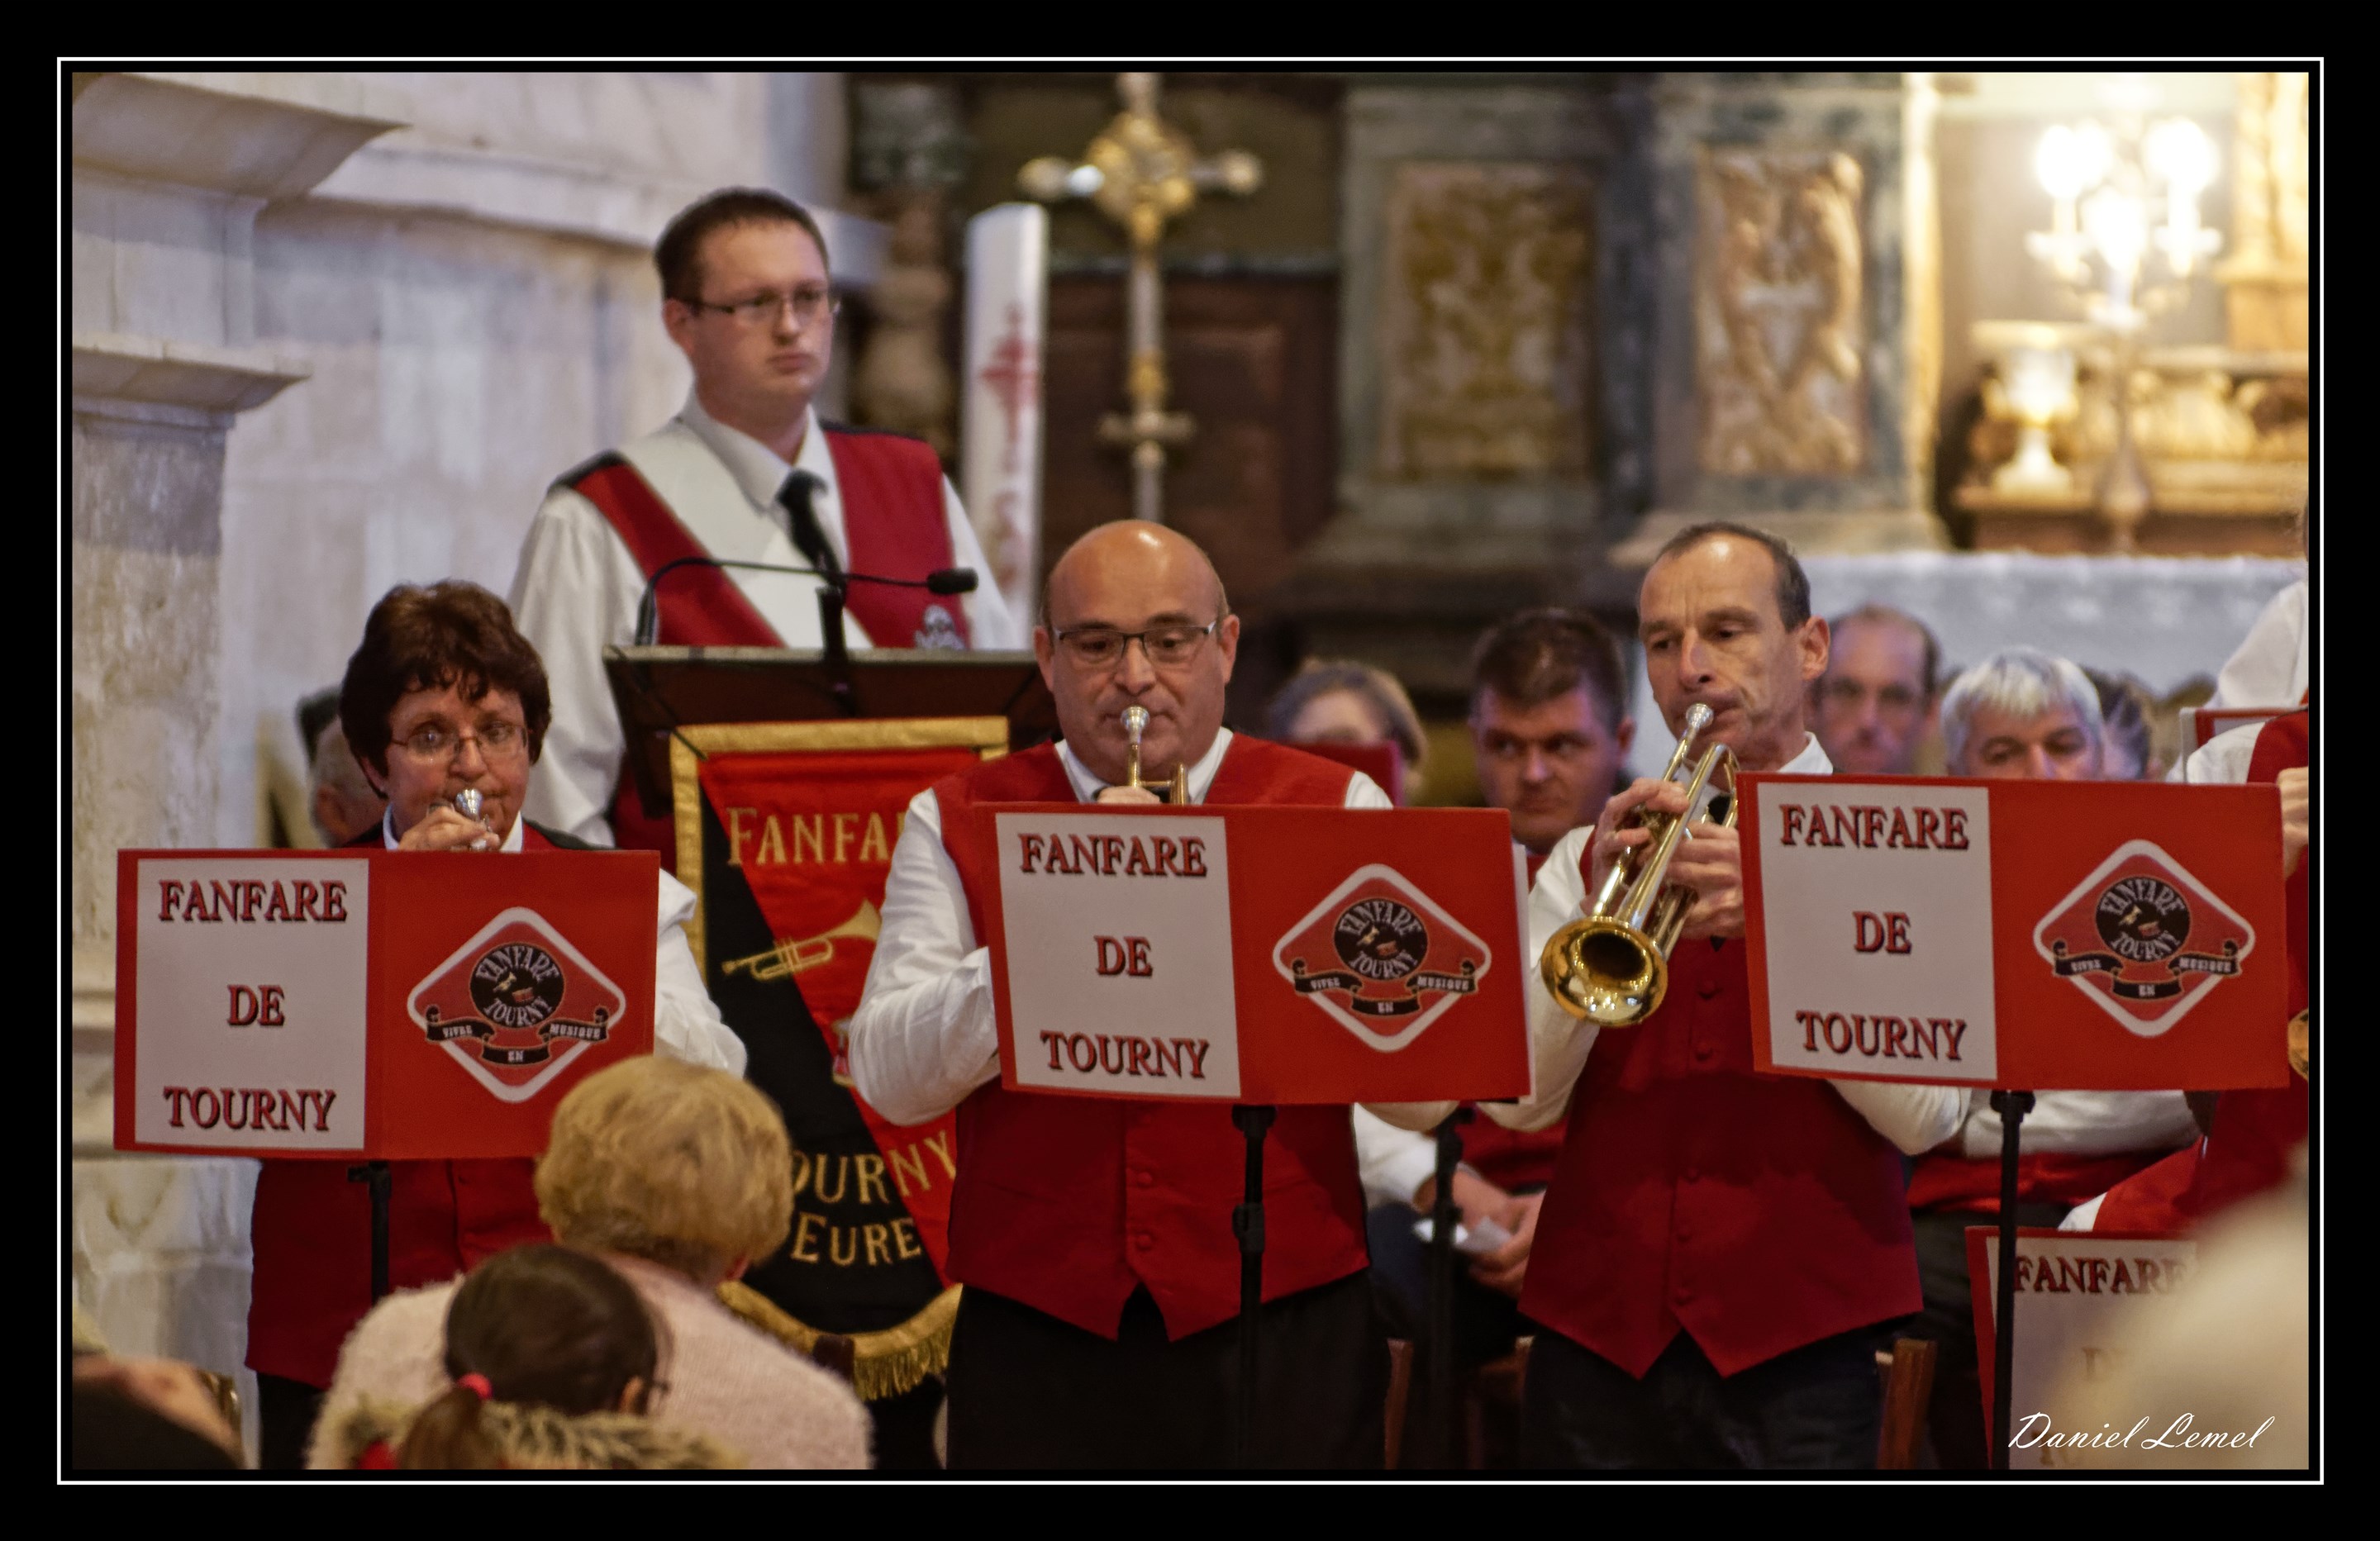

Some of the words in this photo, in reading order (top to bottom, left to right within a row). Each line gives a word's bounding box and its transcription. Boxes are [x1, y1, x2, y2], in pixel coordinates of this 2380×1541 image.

[1780, 804, 1969, 850] FANFARE
[1018, 834, 1207, 878] FANFARE
[159, 879, 347, 922] FANFARE
[1339, 901, 1421, 936] FANFARE
[2100, 878, 2186, 916] FANFARE
[1854, 911, 1912, 955] DE
[2111, 930, 2180, 962] TOURNY
[475, 945, 560, 983] FANFARE
[1094, 936, 1153, 977] DE
[1349, 950, 1418, 978] TOURNY
[227, 985, 285, 1027] DE
[483, 996, 553, 1027] TOURNY
[1040, 1030, 1210, 1079] TOURNY
[1796, 1010, 1967, 1062] TOURNY
[163, 1087, 336, 1131] TOURNY
[791, 1130, 956, 1204] OURNY
[790, 1211, 921, 1266] EURE
